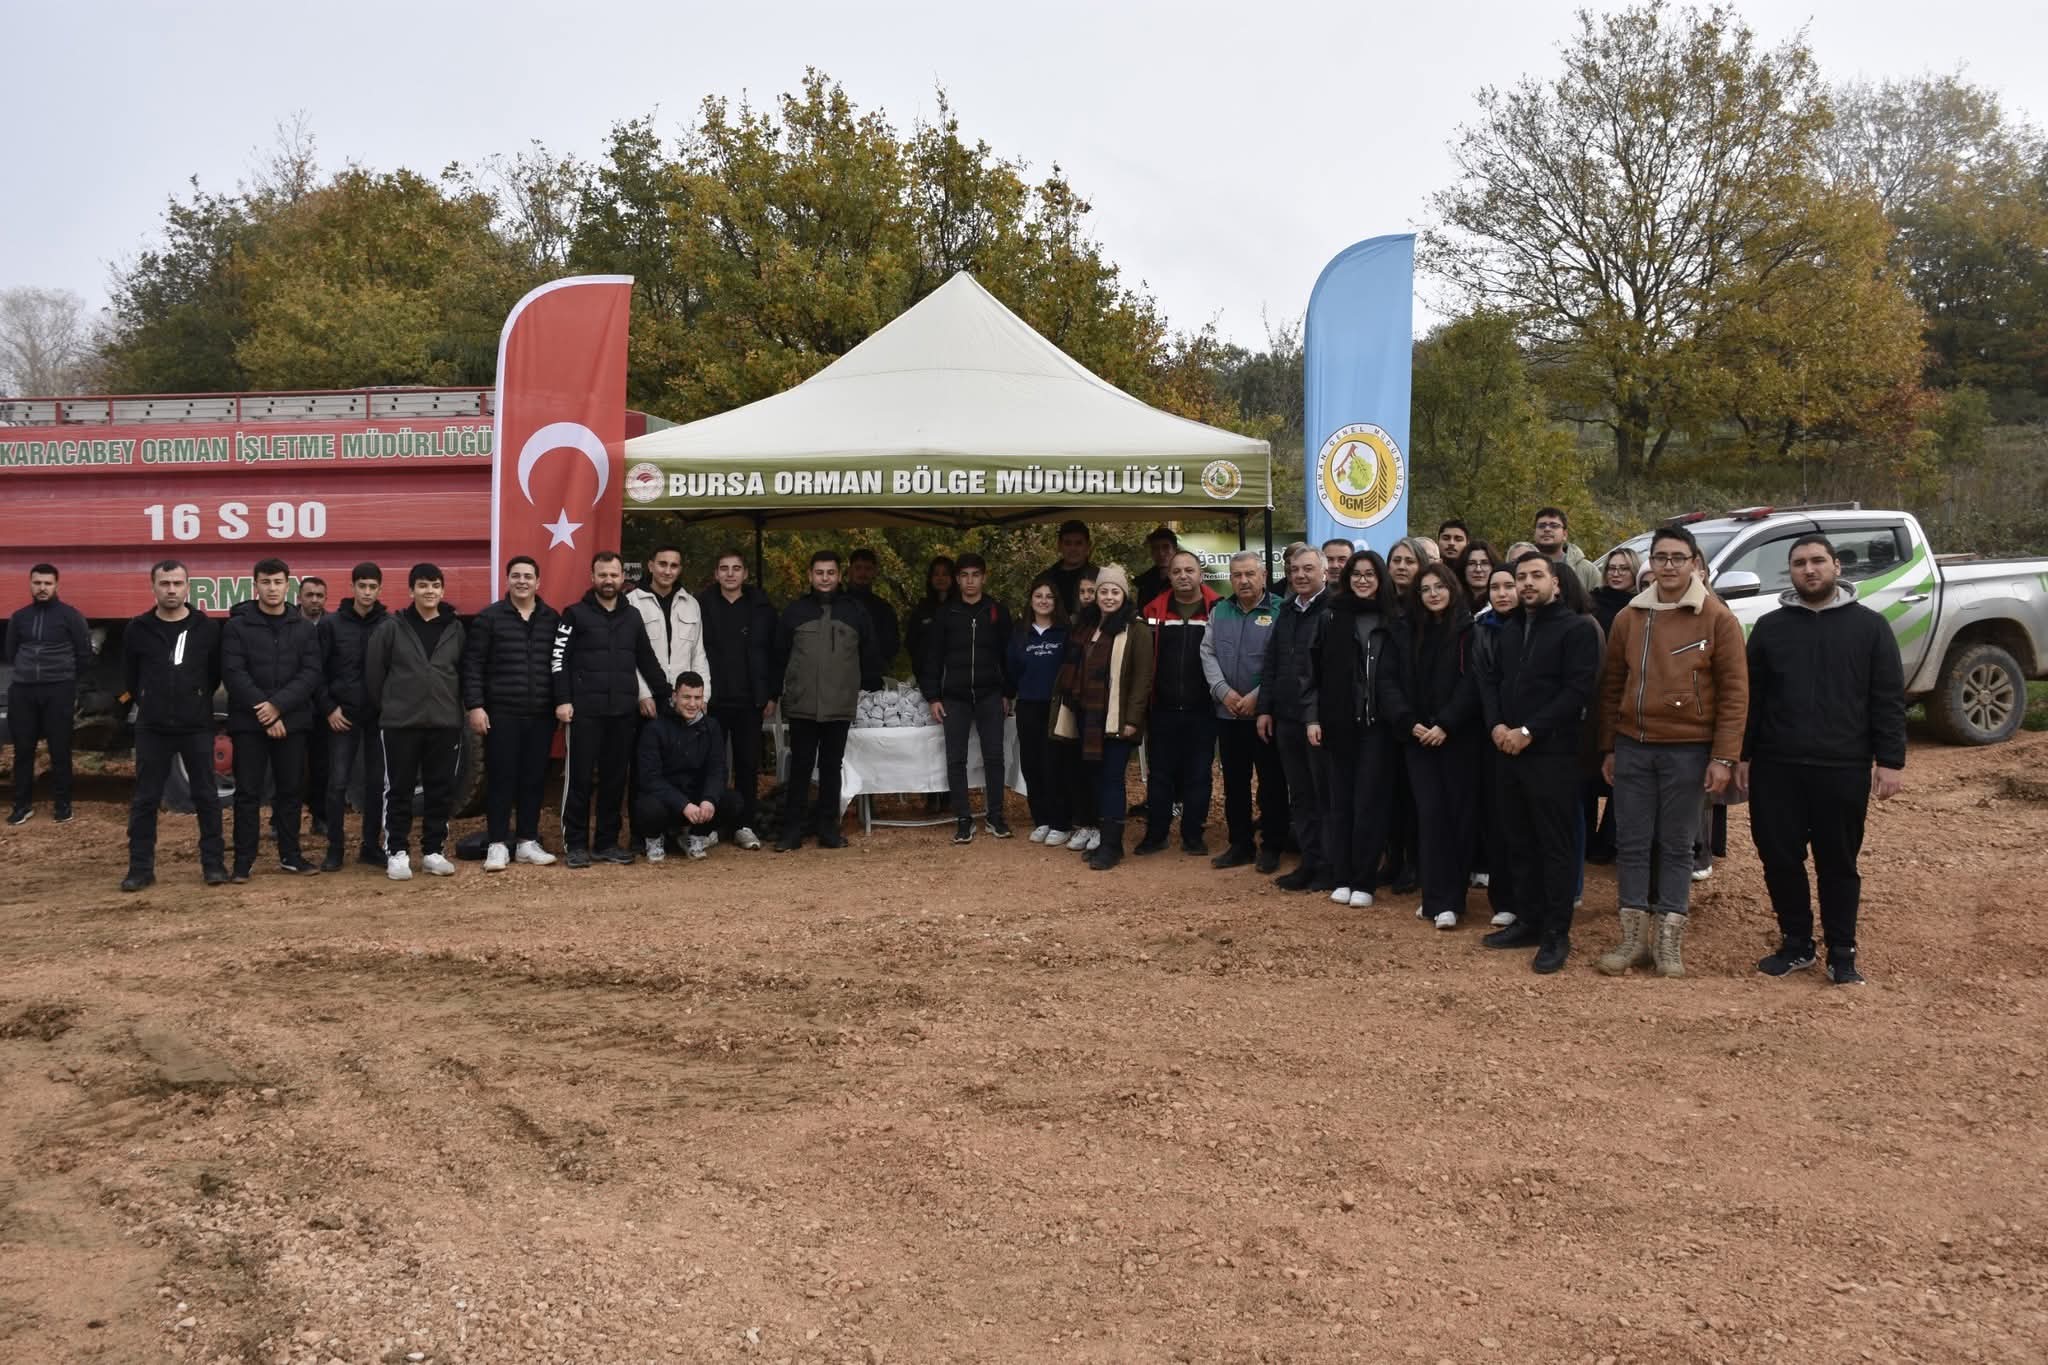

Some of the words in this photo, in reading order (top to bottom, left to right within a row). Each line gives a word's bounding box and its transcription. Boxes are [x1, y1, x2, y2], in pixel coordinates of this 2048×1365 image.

[0, 440, 136, 466] KARACABEY
[141, 437, 229, 464] ORMAN
[235, 431, 335, 464] İŞLETME
[342, 426, 493, 458] MÜDÜRLÜĞÜ
[1317, 454, 1328, 500] ORMAN
[1329, 426, 1364, 447] GENEL
[669, 472, 765, 497] BURSA
[774, 470, 882, 494] ORMAN
[892, 465, 986, 494] BÖLGE
[996, 465, 1184, 494] MÜDÜRLÜĞÜ
[143, 503, 200, 541] 16
[218, 502, 249, 540] S
[266, 501, 326, 539] 90
[1340, 494, 1364, 512] OGM
[1199, 550, 1234, 568] ğam
[184, 575, 318, 611] RMN
